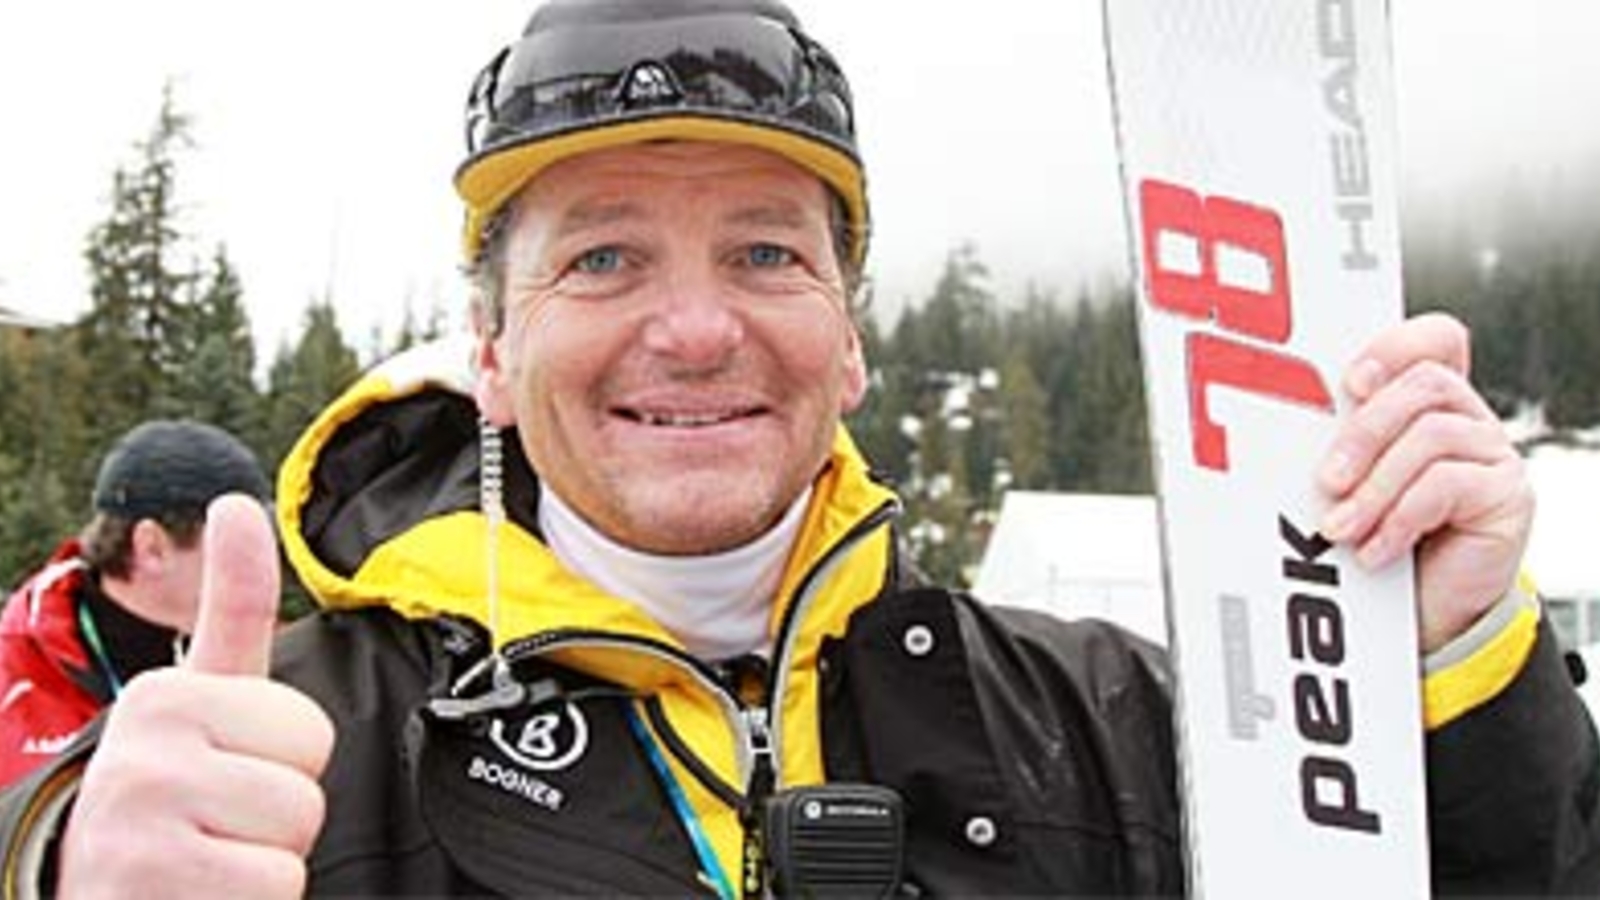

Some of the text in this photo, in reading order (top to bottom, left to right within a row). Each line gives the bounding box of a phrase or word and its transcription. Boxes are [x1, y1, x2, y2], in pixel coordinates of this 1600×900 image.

[1315, 0, 1379, 270] HEAD
[1139, 177, 1337, 472] 78
[467, 756, 564, 811] BOGNER
[1278, 512, 1382, 835] peak
